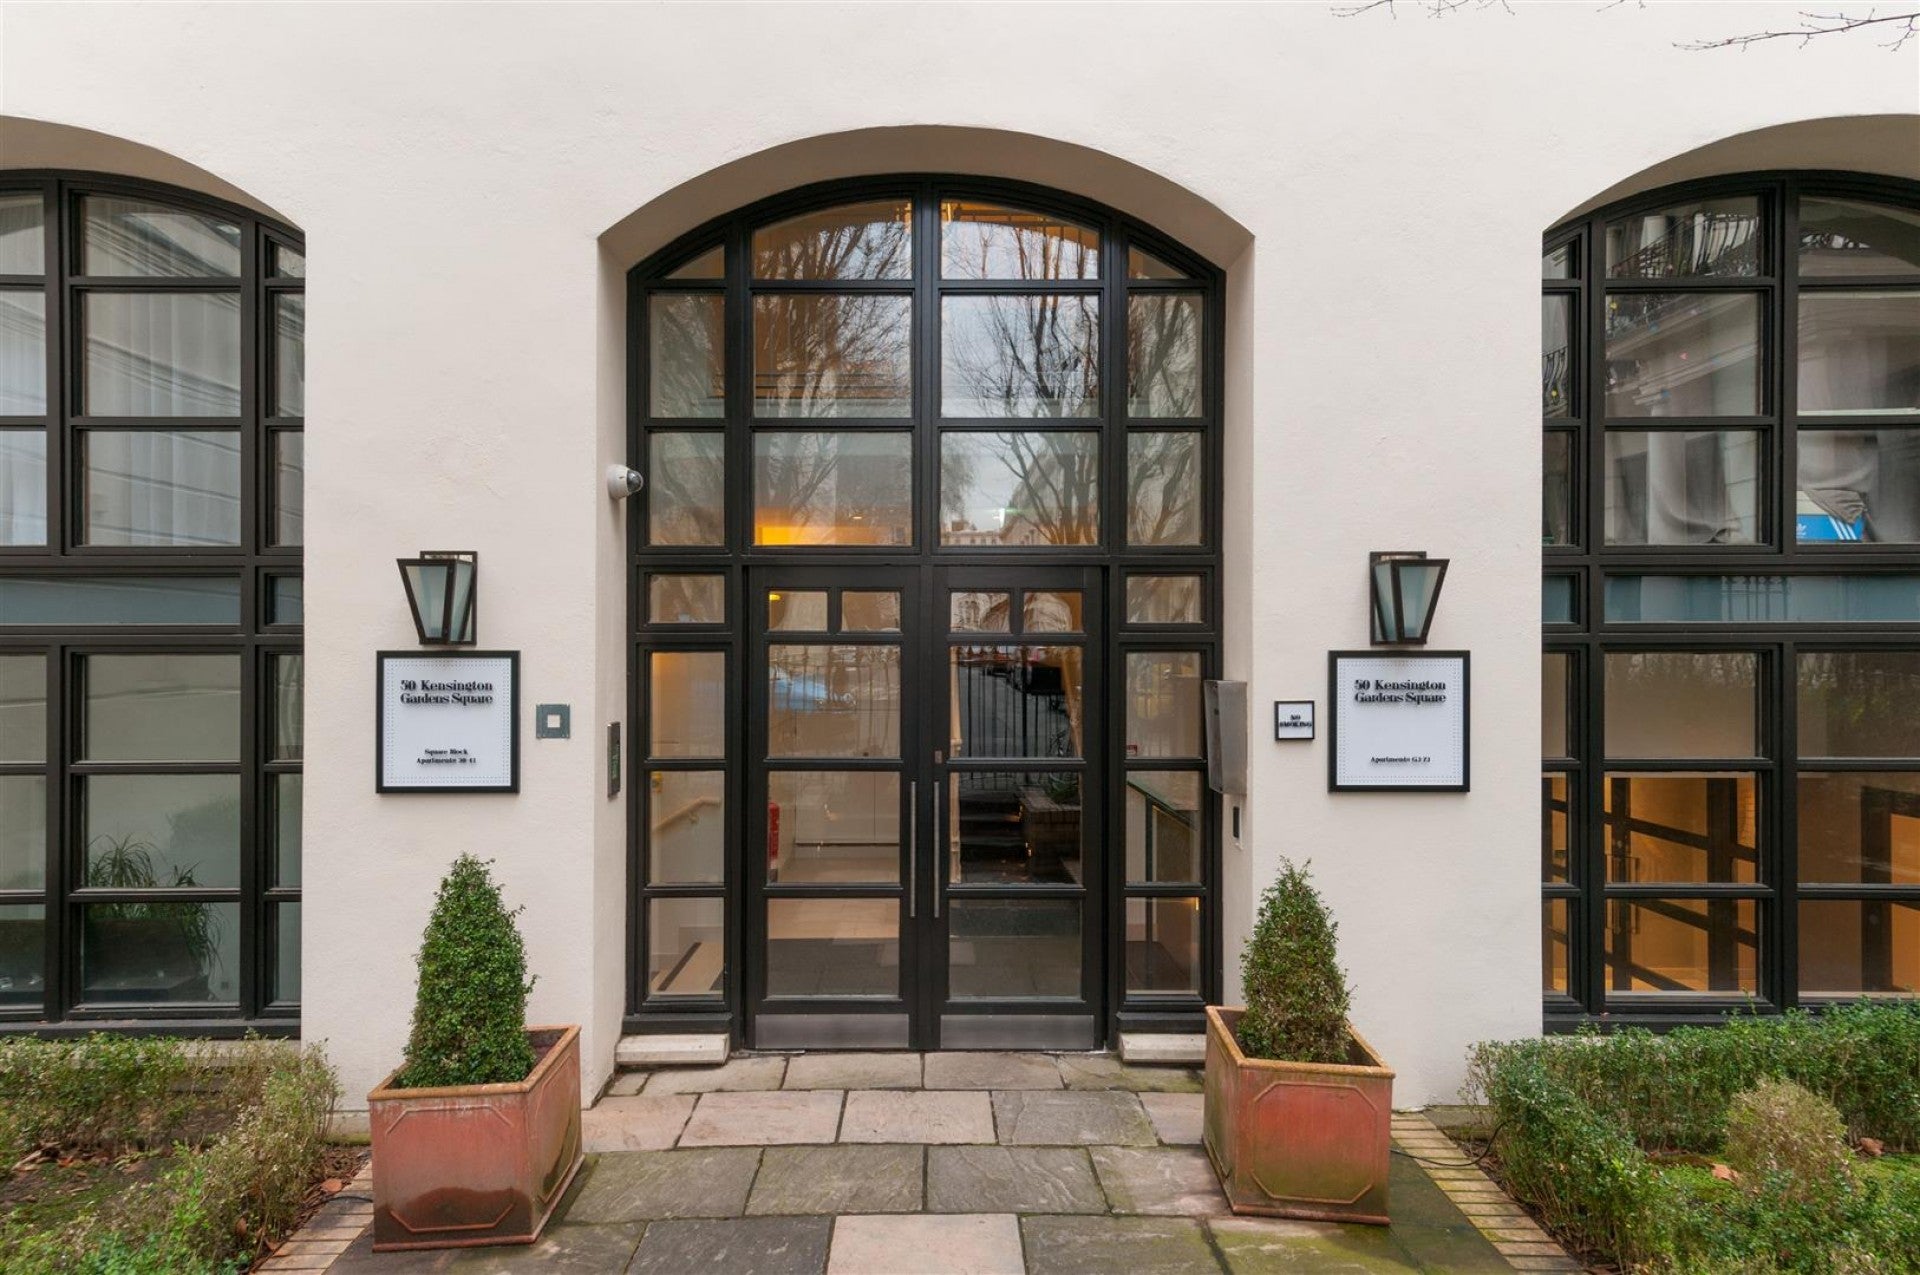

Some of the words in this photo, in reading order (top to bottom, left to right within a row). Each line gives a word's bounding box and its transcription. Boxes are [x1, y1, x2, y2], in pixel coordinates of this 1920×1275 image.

[400, 680, 416, 691] 50
[421, 680, 493, 692] Kensington
[1354, 679, 1370, 690] 50
[1375, 679, 1446, 691] Kensington
[400, 693, 450, 704] Gardens
[451, 693, 493, 706] Square
[1355, 692, 1403, 703] Gardens
[1405, 692, 1446, 705] Square
[1370, 756, 1410, 764] Apartments
